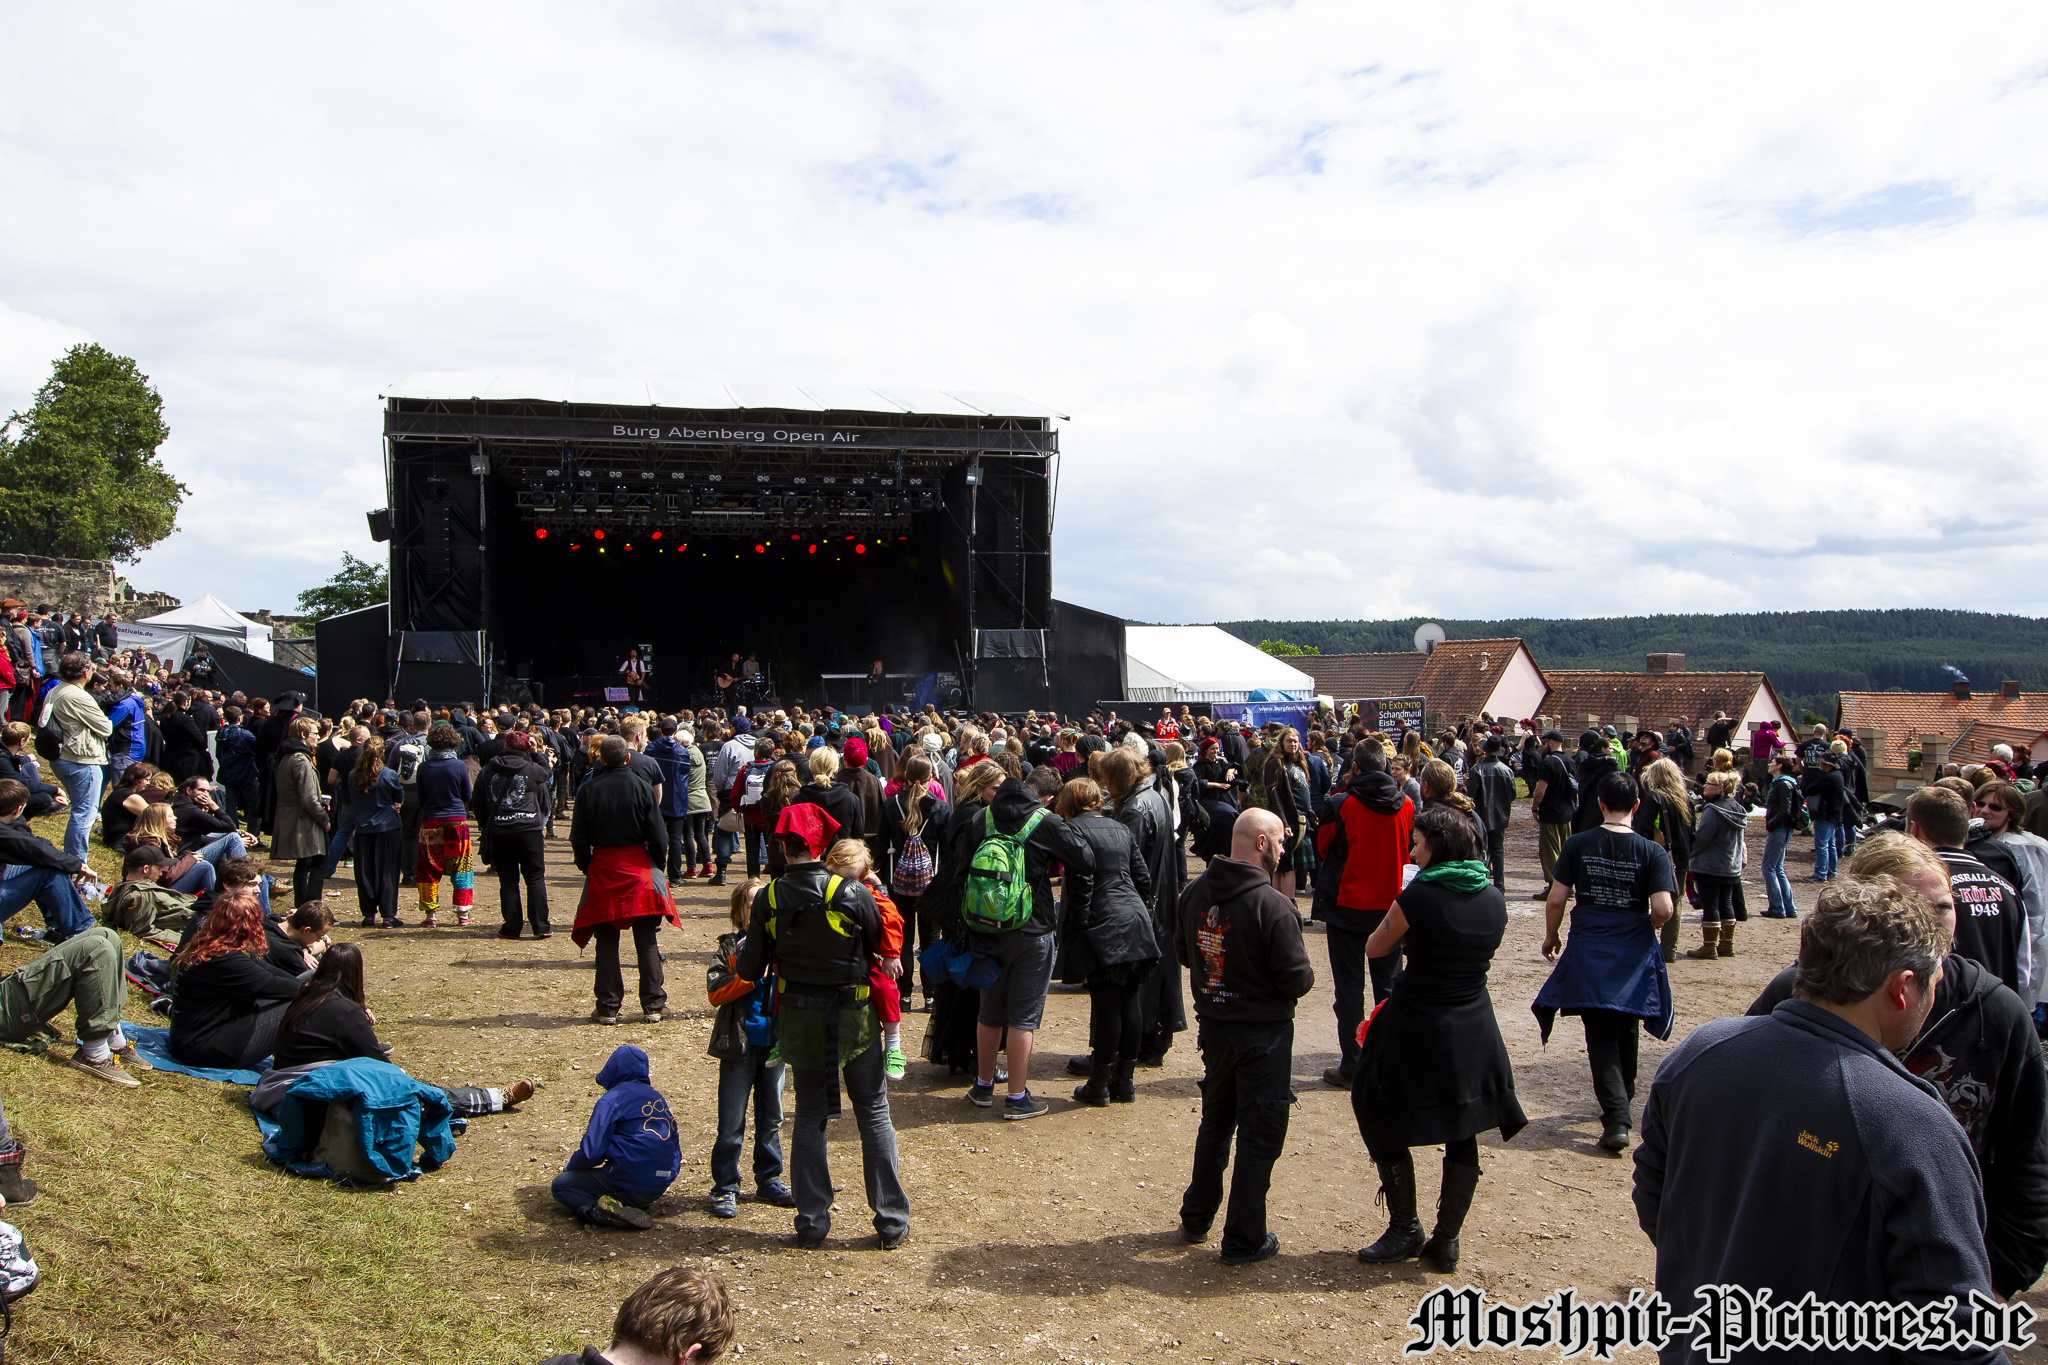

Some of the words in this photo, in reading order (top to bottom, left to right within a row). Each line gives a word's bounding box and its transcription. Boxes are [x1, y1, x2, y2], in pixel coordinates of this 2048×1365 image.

[613, 425, 660, 439] Burg
[668, 427, 765, 442] Abenberg
[773, 430, 825, 443] Open
[832, 431, 860, 442] Air
[1258, 704, 1315, 713] www.burgfestivals.de
[1379, 701, 1387, 710] In
[1388, 700, 1422, 710] Extremo
[1379, 709, 1422, 719] Schandmaul
[1959, 885, 2003, 903] KÖLN
[1970, 903, 2000, 917] 1948
[1799, 1130, 1820, 1144] Jack
[1798, 1135, 1833, 1159] Wolfskin
